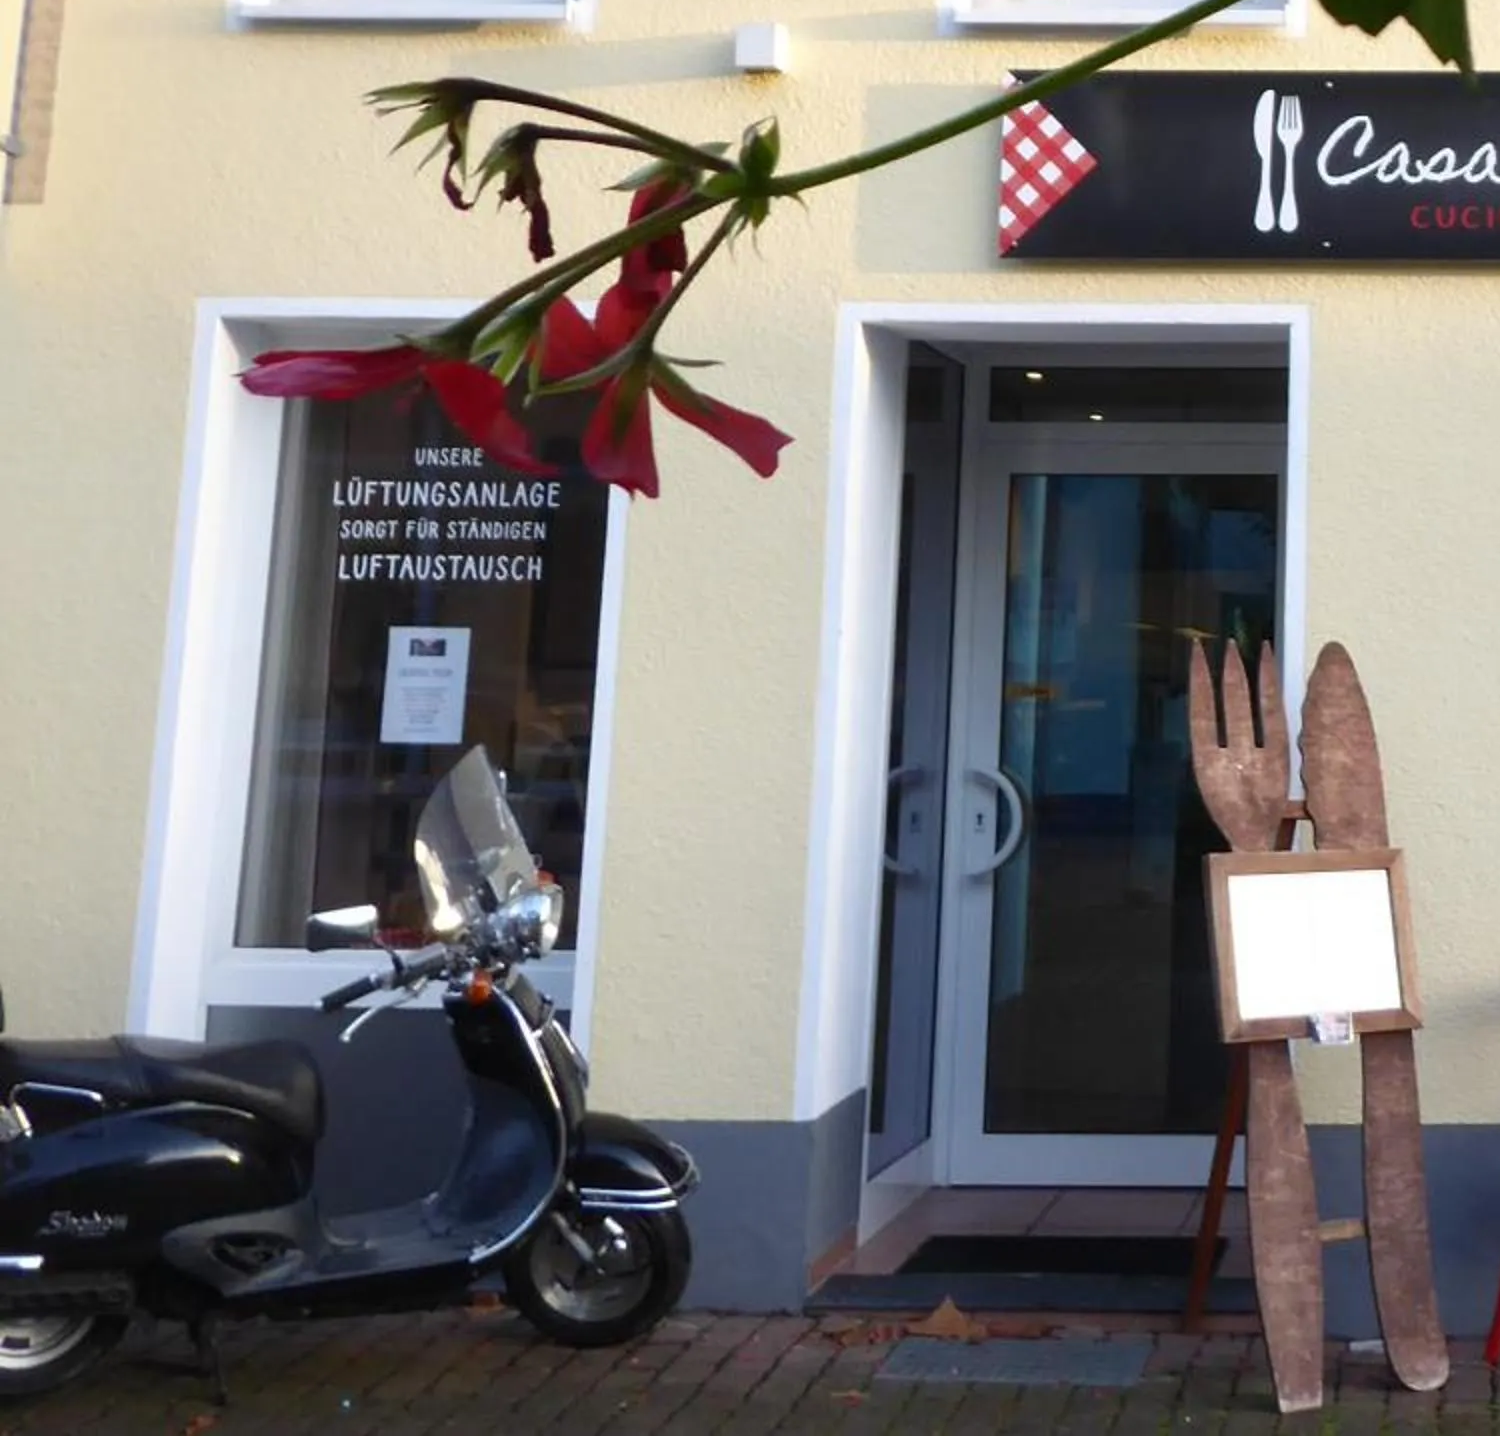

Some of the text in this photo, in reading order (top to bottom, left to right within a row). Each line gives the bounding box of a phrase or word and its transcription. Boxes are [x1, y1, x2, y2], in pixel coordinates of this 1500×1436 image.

[415, 447, 484, 467] UNSERE
[332, 476, 561, 508] LÜFTUNGSANLAGE
[340, 517, 547, 540] SORGT FÜR STÄNDIGEN
[338, 554, 543, 581] LUFTAUSTAUSCH
